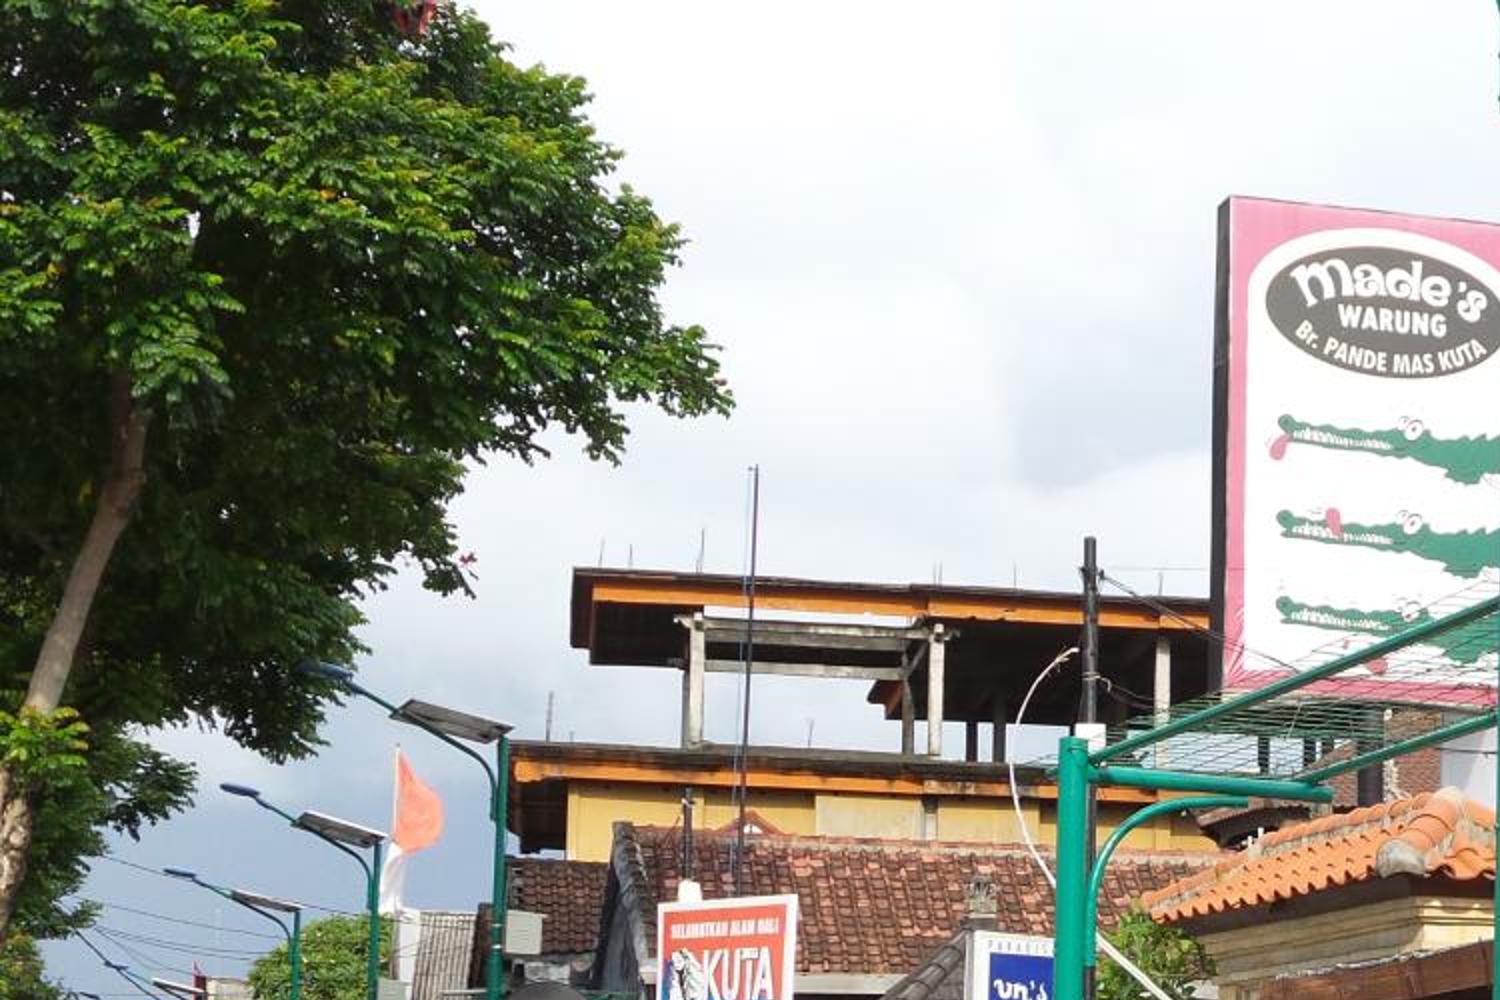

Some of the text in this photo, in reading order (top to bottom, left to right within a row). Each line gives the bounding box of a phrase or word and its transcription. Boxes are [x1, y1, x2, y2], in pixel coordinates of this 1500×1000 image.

[1338, 303, 1447, 338] WARUNG
[1295, 320, 1487, 374] Br. PANDE MAS KUTA
